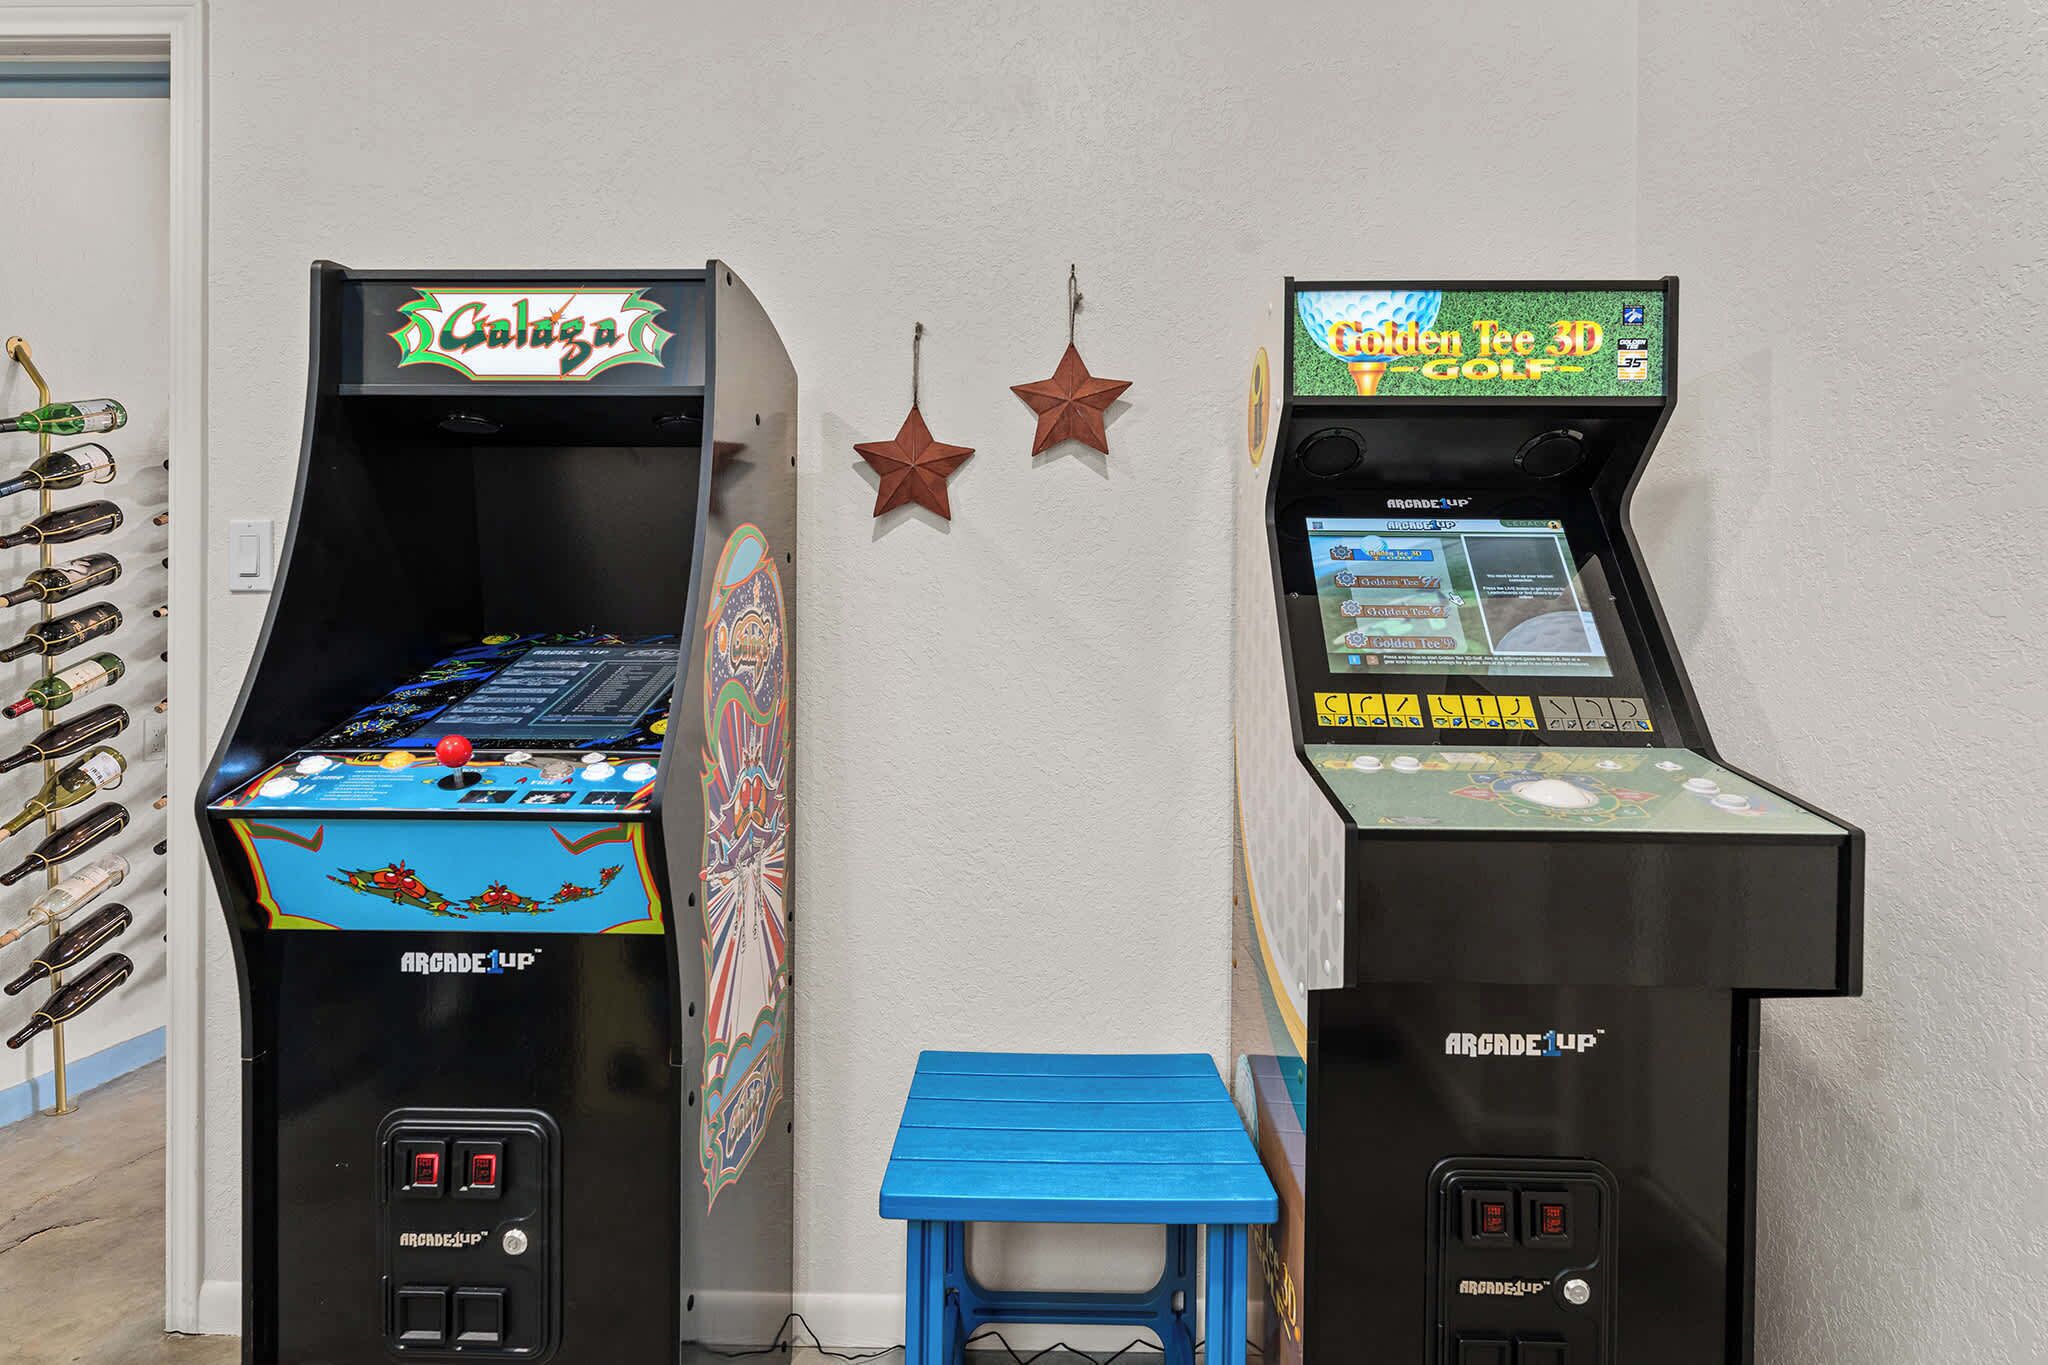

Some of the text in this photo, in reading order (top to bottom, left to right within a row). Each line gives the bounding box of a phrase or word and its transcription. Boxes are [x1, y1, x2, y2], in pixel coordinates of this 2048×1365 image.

[438, 298, 624, 379] Galaga
[1327, 320, 1603, 356] Golden Tee 3D
[1421, 358, 1556, 380] GOLF
[1624, 357, 1642, 369] 35
[1367, 607, 1408, 616] Golden
[1411, 608, 1429, 616] Tee
[1374, 639, 1416, 648] Golden
[1420, 639, 1440, 648] Tee
